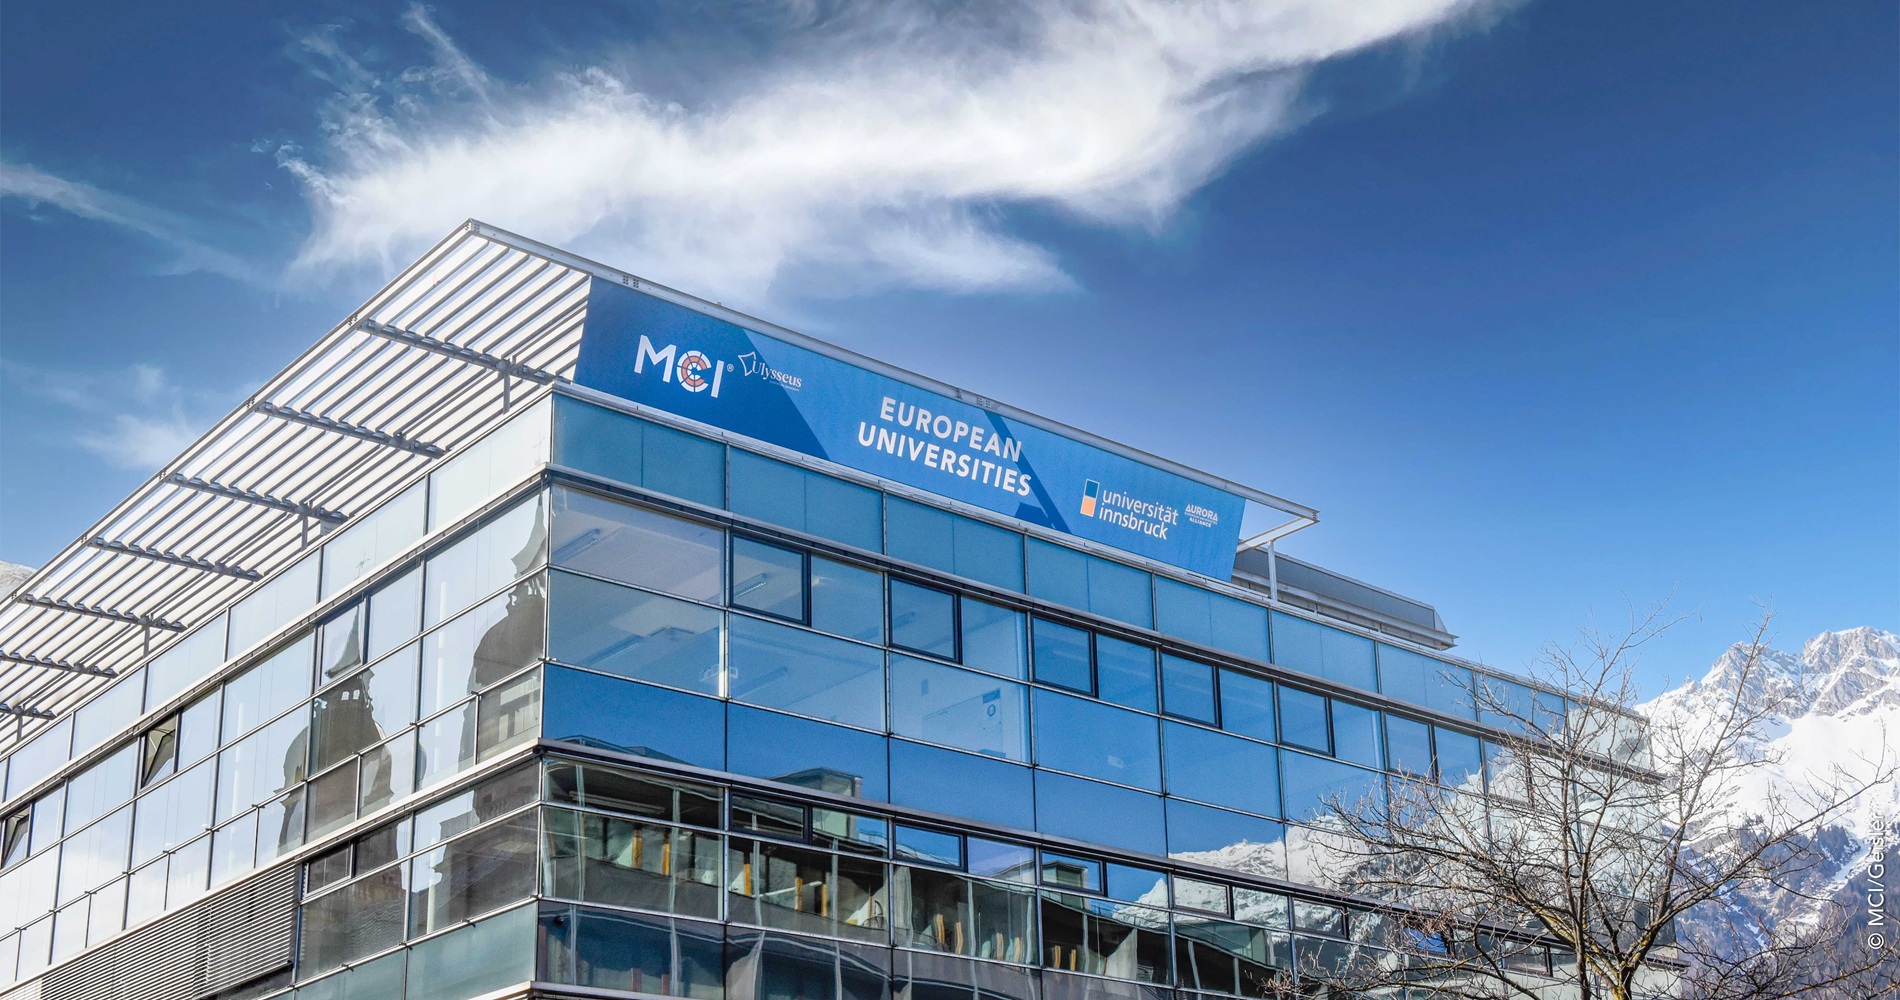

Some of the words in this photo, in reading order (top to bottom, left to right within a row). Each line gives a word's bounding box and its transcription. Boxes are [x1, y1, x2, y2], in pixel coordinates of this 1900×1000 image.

[752, 358, 802, 388] Ulysseus
[880, 396, 1022, 462] EUROPEAN
[858, 422, 1032, 496] UNIVERSITIES
[1099, 502, 1169, 540] innsbruck
[1102, 489, 1179, 526] universität
[1185, 504, 1218, 521] AURORA
